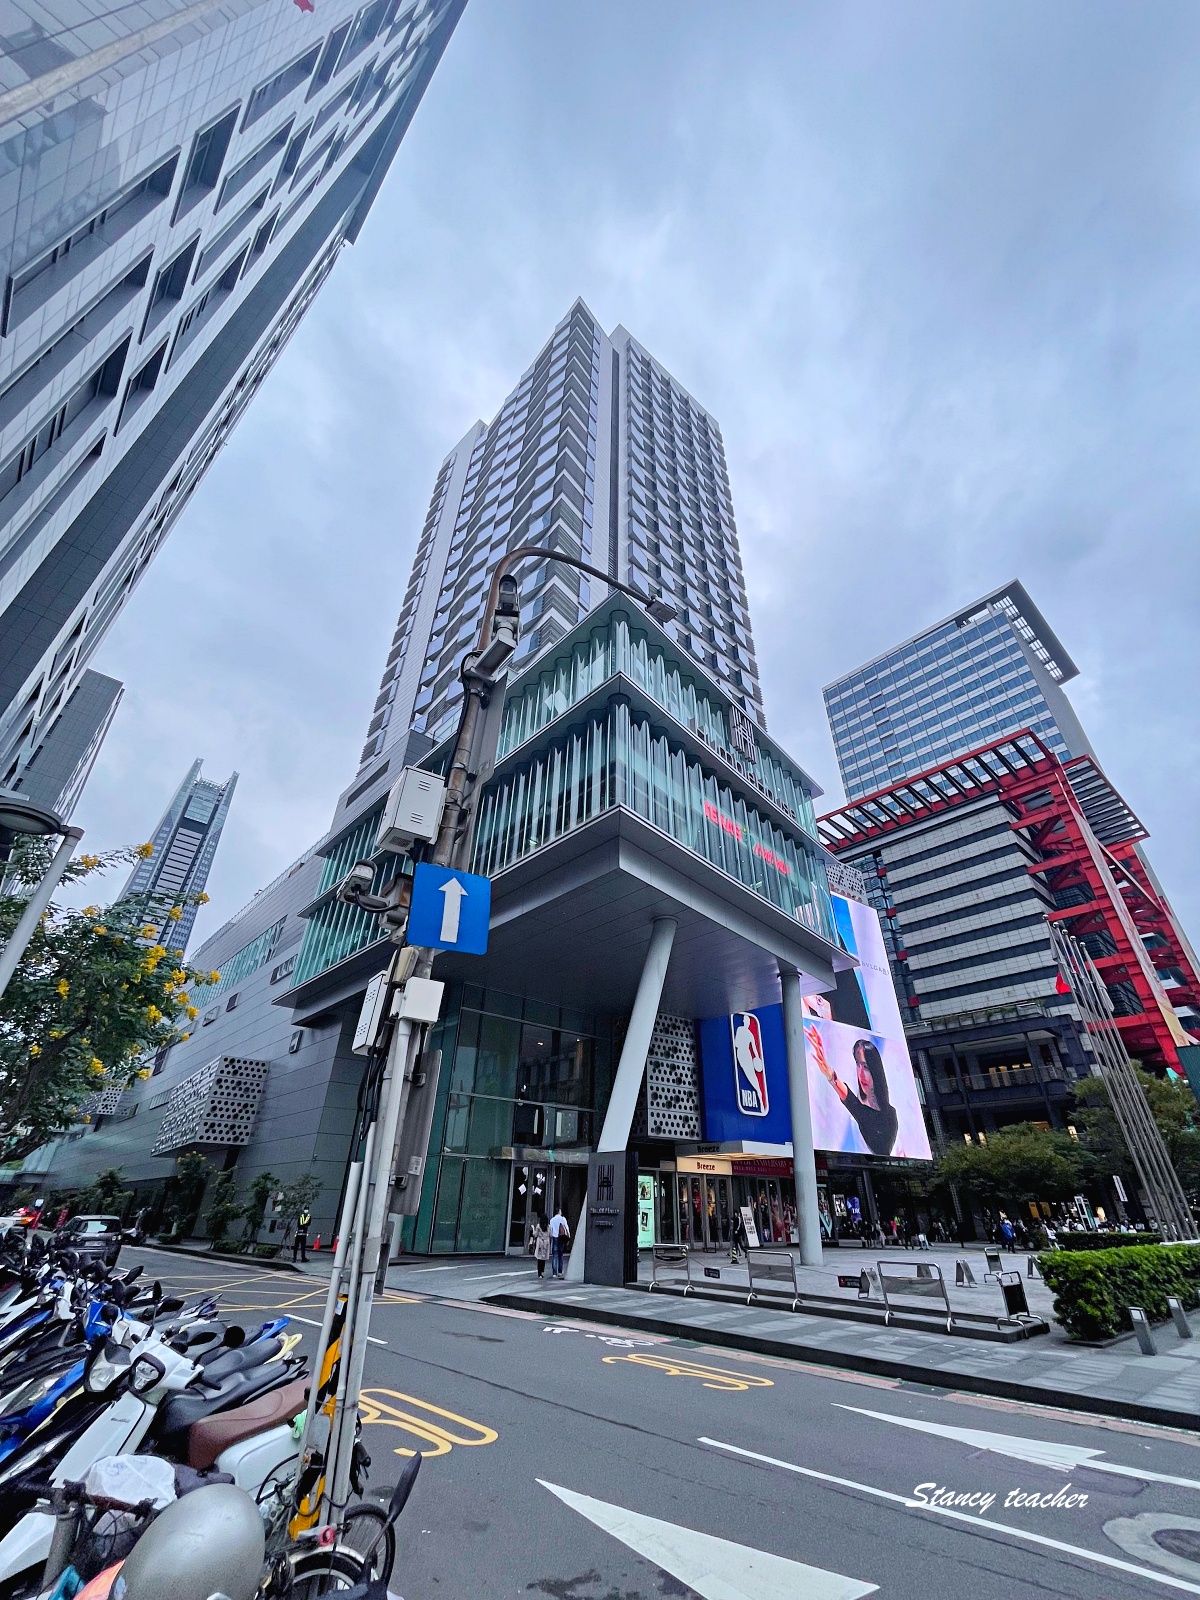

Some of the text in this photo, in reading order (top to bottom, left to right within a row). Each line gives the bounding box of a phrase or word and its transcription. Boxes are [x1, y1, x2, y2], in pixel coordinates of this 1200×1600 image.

[741, 1089, 758, 1108] NBA
[697, 1145, 719, 1153] Breeze
[696, 1161, 716, 1171] Breeze
